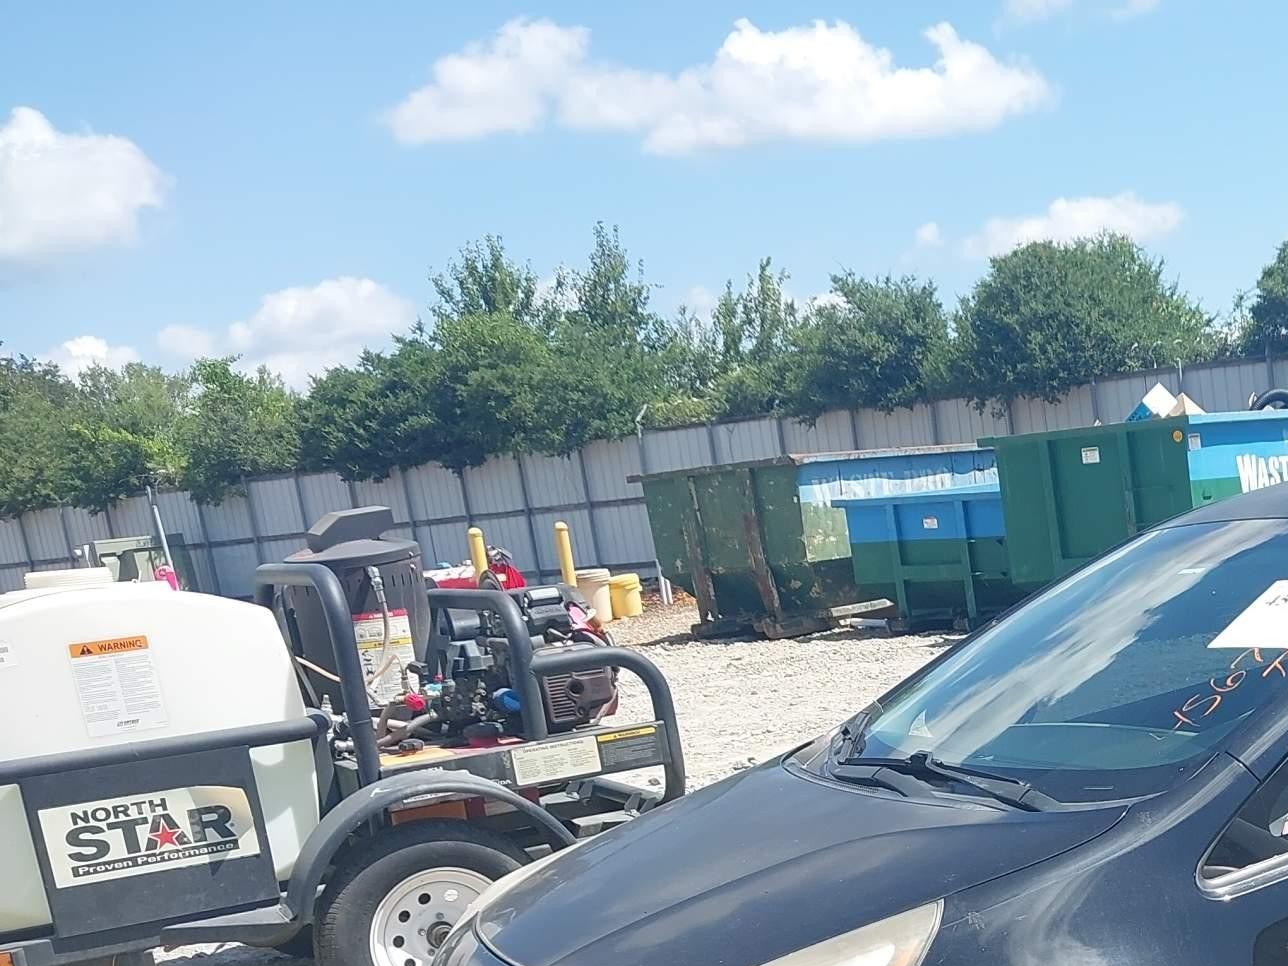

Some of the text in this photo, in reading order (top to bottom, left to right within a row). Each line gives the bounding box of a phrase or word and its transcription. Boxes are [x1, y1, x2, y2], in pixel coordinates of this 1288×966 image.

[97, 639, 143, 652] WARNING
[70, 798, 167, 826] NORTH
[65, 805, 238, 863] STAR
[78, 842, 234, 876] Proven Performance
